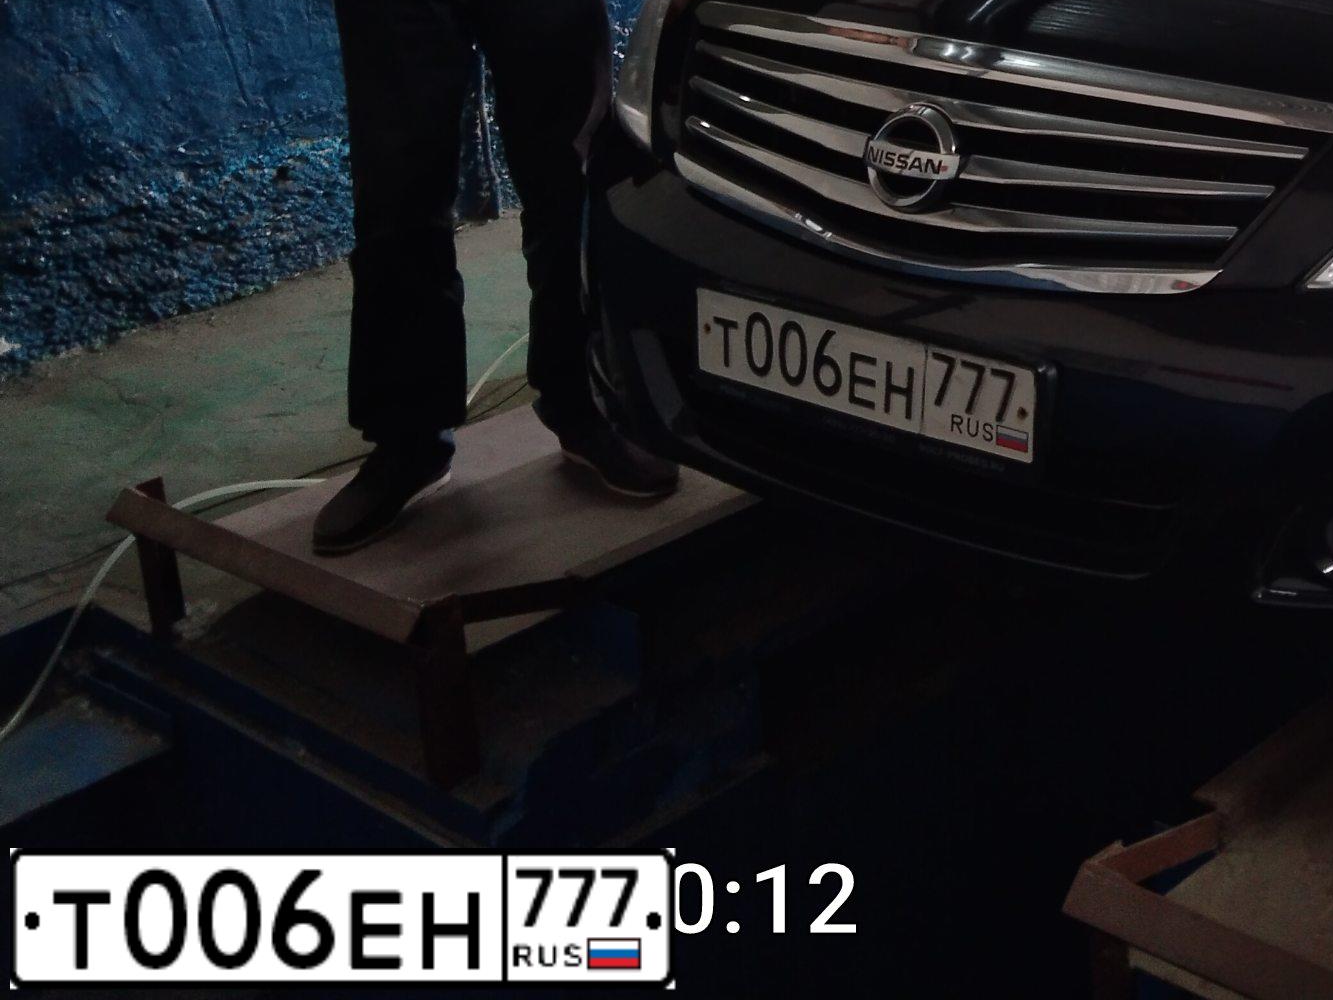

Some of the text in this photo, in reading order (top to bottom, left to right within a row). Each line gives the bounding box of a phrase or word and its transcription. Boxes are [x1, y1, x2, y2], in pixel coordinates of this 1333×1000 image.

[867, 146, 942, 175] NISSAN
[932, 352, 1017, 422] 777
[951, 413, 994, 442] RUS
